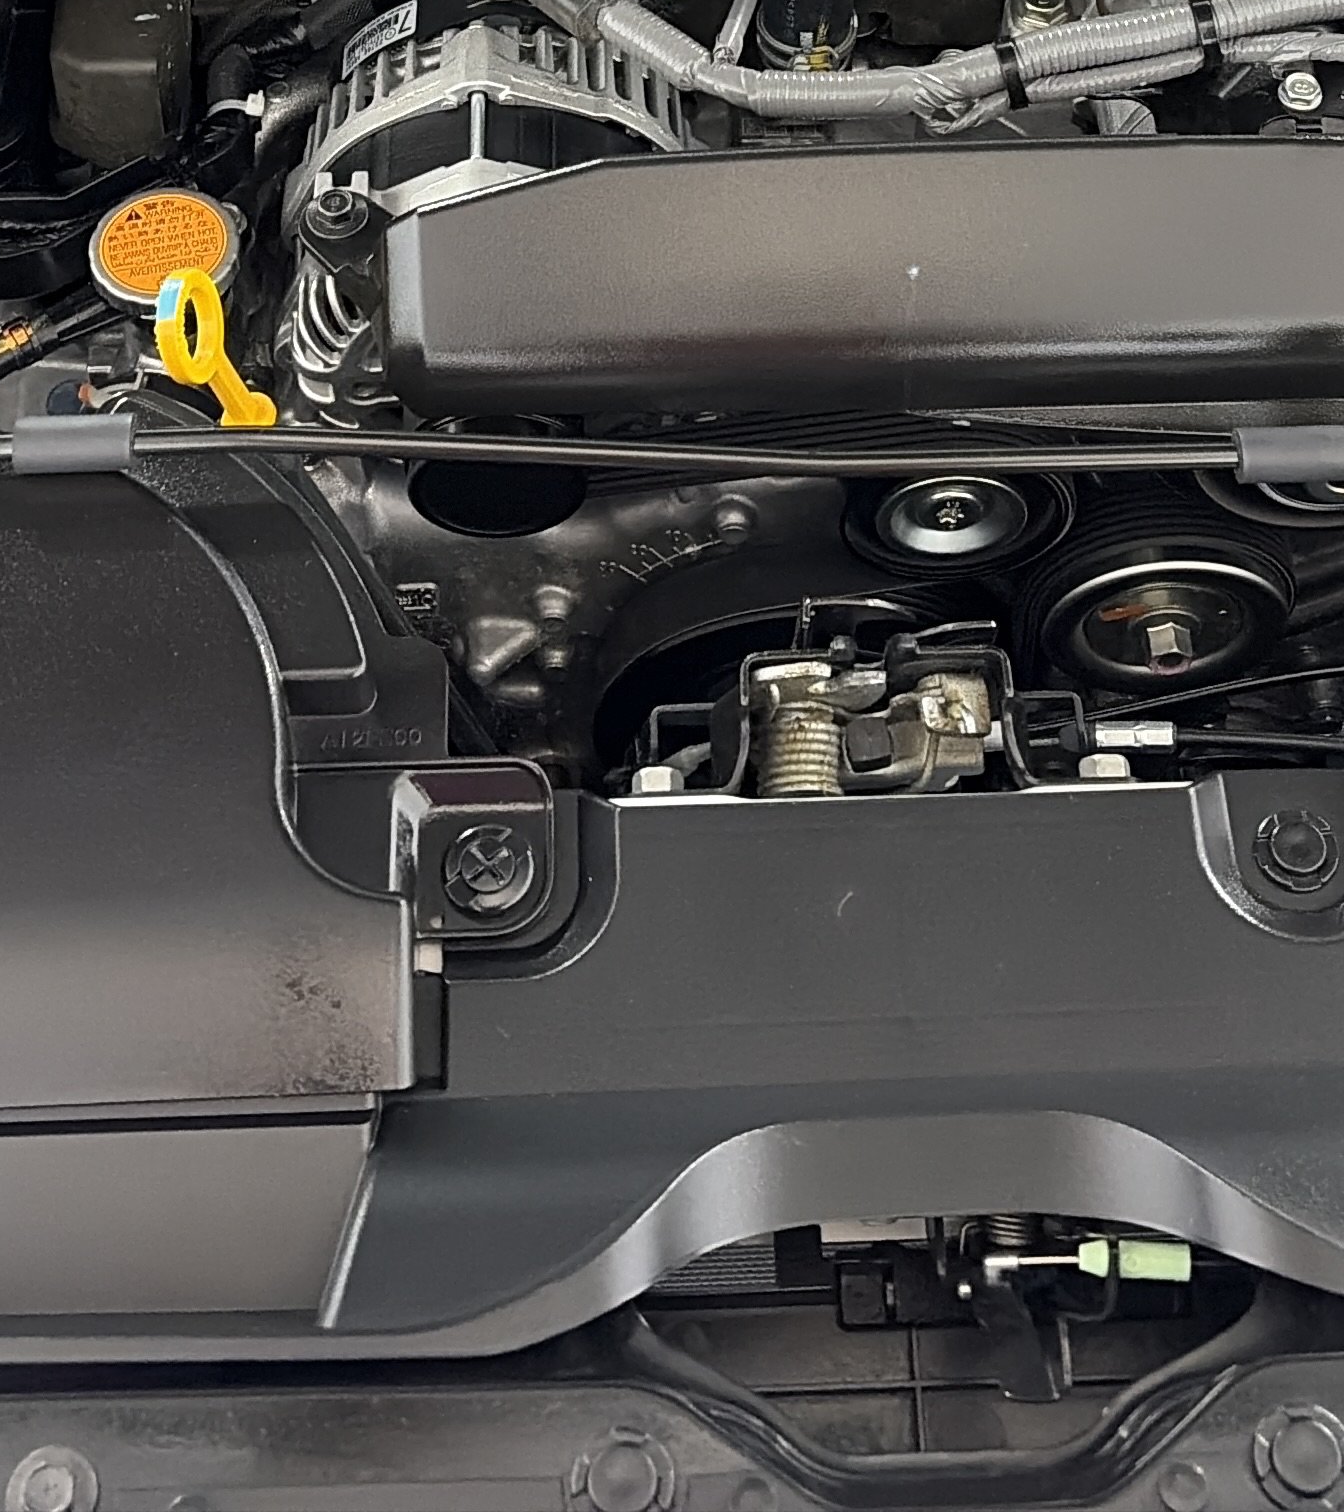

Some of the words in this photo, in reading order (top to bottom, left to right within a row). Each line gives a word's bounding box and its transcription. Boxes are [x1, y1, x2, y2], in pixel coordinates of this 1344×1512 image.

[143, 205, 193, 220] WARNING
[140, 236, 165, 248] OPEN
[167, 231, 195, 242] WHEN
[129, 256, 205, 278] AVERTISSEMENT
